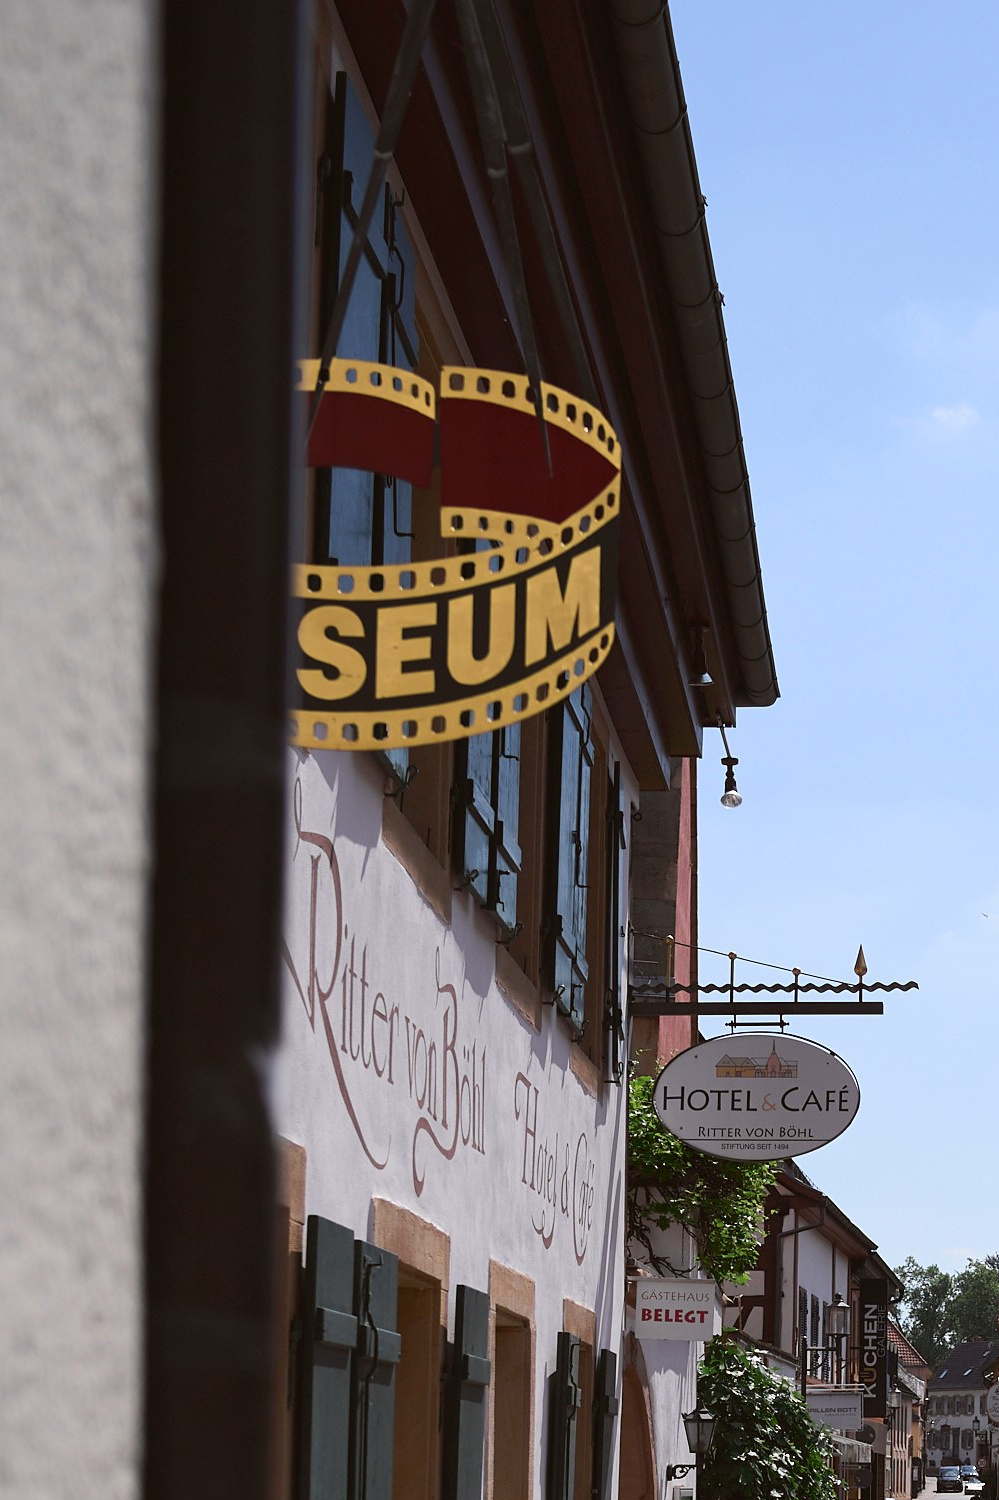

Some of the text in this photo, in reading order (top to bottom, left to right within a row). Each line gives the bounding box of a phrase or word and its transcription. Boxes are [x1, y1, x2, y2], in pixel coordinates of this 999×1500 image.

[296, 546, 602, 701] SEUM
[283, 777, 486, 1198] Ritter von Böhl
[662, 1084, 850, 1112] HOTEL & CAFÉ
[698, 1125, 814, 1138] RITTER VON BÖHL
[514, 1071, 559, 1250] Hotel
[573, 1132, 596, 1266] Café
[641, 1289, 710, 1302] GÄSTEHAUS
[641, 1308, 709, 1324] BELEGT
[861, 1303, 878, 1399] KÜCHEN
[877, 1304, 886, 1358] GALERIE
